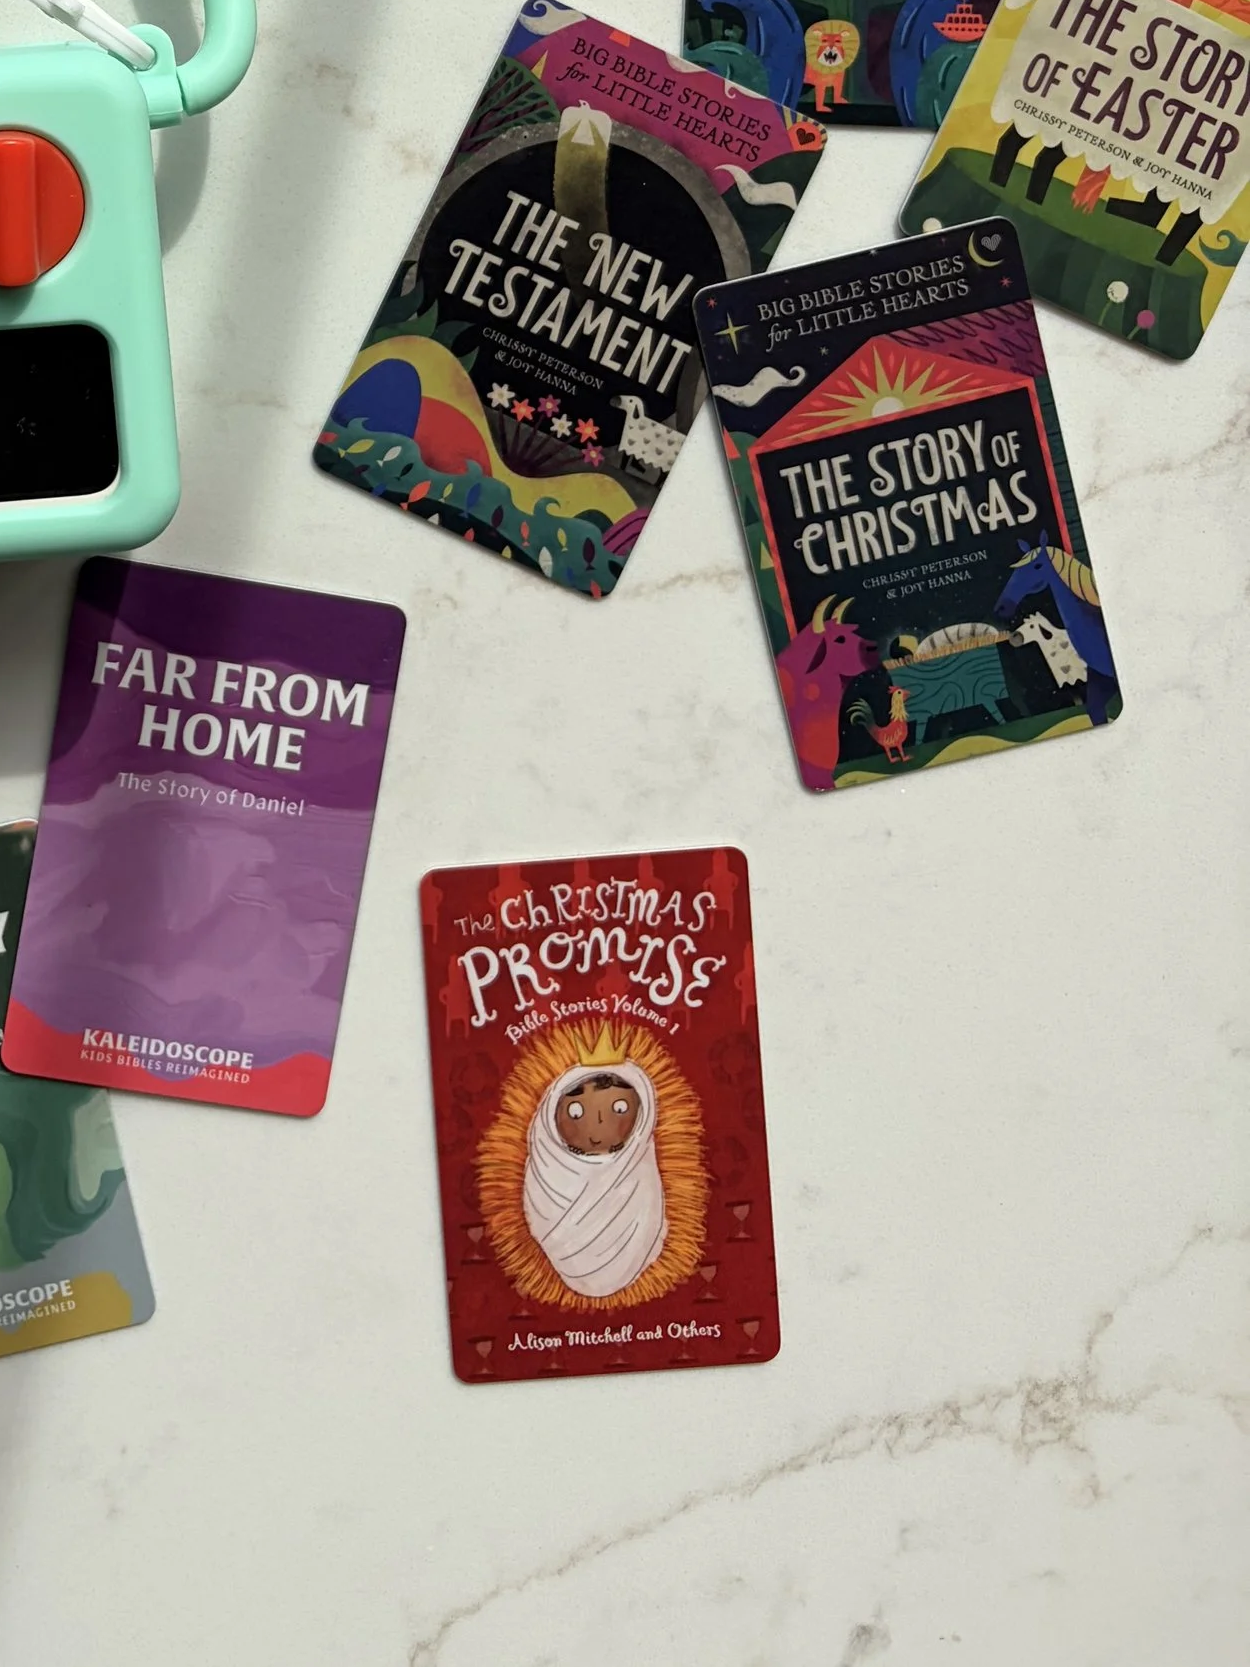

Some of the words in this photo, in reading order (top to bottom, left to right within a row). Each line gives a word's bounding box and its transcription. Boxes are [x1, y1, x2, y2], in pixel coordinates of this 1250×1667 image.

[556, 62, 589, 82] for
[592, 74, 671, 121] LITTLE
[673, 112, 761, 162] HEARTS
[571, 38, 610, 66] BIG
[610, 55, 676, 97] BIBLE
[678, 87, 772, 141] STORIES
[1022, 52, 1068, 99] OF
[1072, 62, 1240, 181] EASTER
[1014, 99, 1068, 129] CHRISSY
[1067, 124, 1131, 160] PETERSON
[1133, 157, 1144, 167] &
[1145, 161, 1171, 178] JOY
[1171, 176, 1212, 200] HANNA
[492, 190, 580, 272] THE
[583, 232, 694, 322] NEW
[758, 298, 796, 321] BIG
[799, 280, 865, 311] BIBLE
[869, 255, 965, 294] STORIES
[444, 238, 692, 394] TESTAMENT
[766, 323, 792, 352] for
[797, 302, 876, 336] LITTLE
[881, 279, 969, 314] HEARTS
[483, 327, 537, 357] CHRISSY
[538, 353, 604, 389] PETERSON
[495, 350, 507, 361] &
[506, 356, 534, 373] JOY
[535, 369, 577, 395] HANNA
[779, 454, 861, 519] THE
[867, 420, 986, 498] STORY
[990, 431, 1023, 468] OF
[793, 470, 1038, 574] CHRISTMAS
[863, 567, 917, 589] CHRISSY
[921, 550, 987, 574] PETERSON
[887, 589, 897, 599] &
[901, 581, 925, 597] JOY
[928, 570, 972, 588] HANNA
[91, 641, 197, 700] FAR
[211, 660, 370, 727] FROM
[138, 704, 306, 771] HOME
[118, 772, 152, 792] The
[158, 778, 211, 806] Story
[216, 789, 238, 806] of
[242, 792, 305, 816] Daniel
[454, 914, 495, 936] The
[83, 1028, 254, 1070] KALEIDOSCOPE
[504, 1009, 549, 1045] Bible
[550, 997, 607, 1021] Stories
[611, 994, 668, 1027] Volume
[669, 1022, 680, 1035] 1
[80, 1050, 112, 1063] KIDS
[117, 1056, 161, 1071] BIBLES
[166, 1062, 250, 1084] REIMAGINED
[508, 1333, 562, 1351] Alison
[565, 1324, 633, 1346] Mitchell
[636, 1325, 663, 1341] and
[667, 1320, 721, 1339] Others
